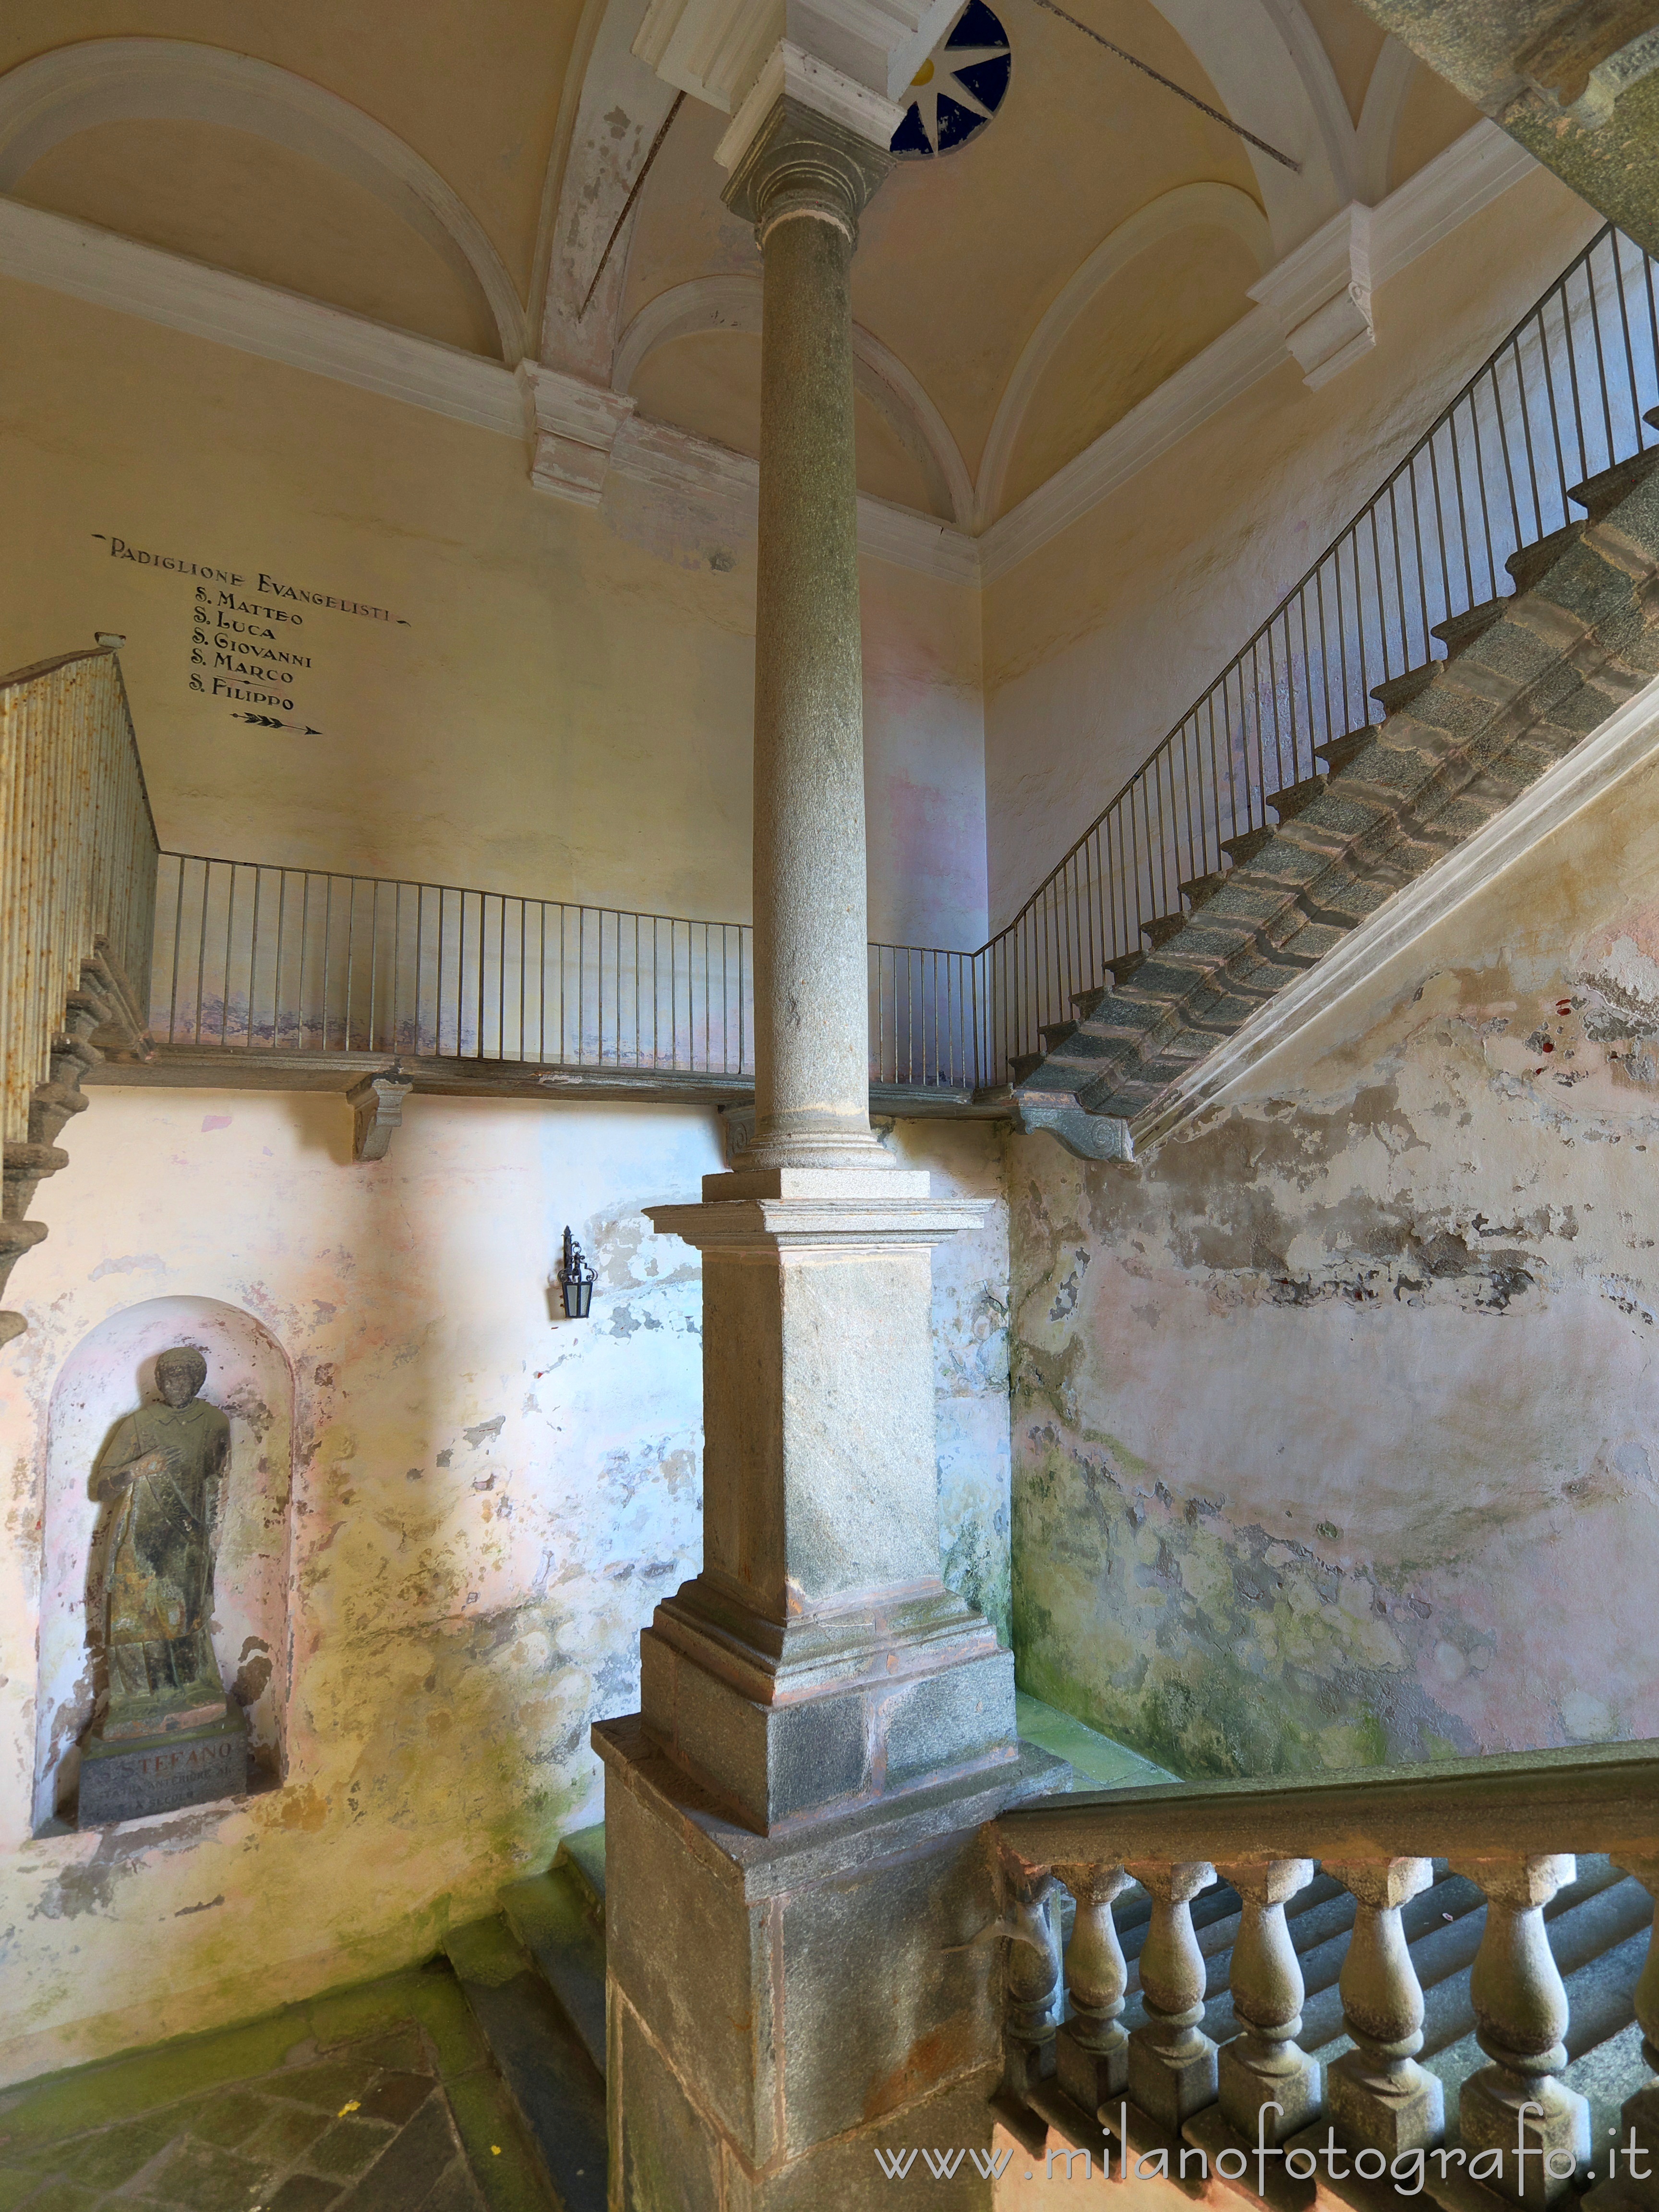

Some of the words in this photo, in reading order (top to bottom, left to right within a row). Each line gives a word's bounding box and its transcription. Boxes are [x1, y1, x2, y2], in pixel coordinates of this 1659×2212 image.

[111, 537, 245, 586] PADIGLIONE
[257, 573, 389, 621] EVANGELISTI
[193, 606, 210, 625] S.
[216, 611, 276, 639] LUCA
[195, 586, 212, 604] S.
[216, 590, 303, 625] MATTEO
[191, 648, 206, 666] S.
[214, 652, 294, 683] MARCO
[192, 627, 209, 646] S.
[214, 632, 312, 668] GIOVANNI
[189, 673, 205, 692] S.
[212, 676, 294, 710] FILIPPO
